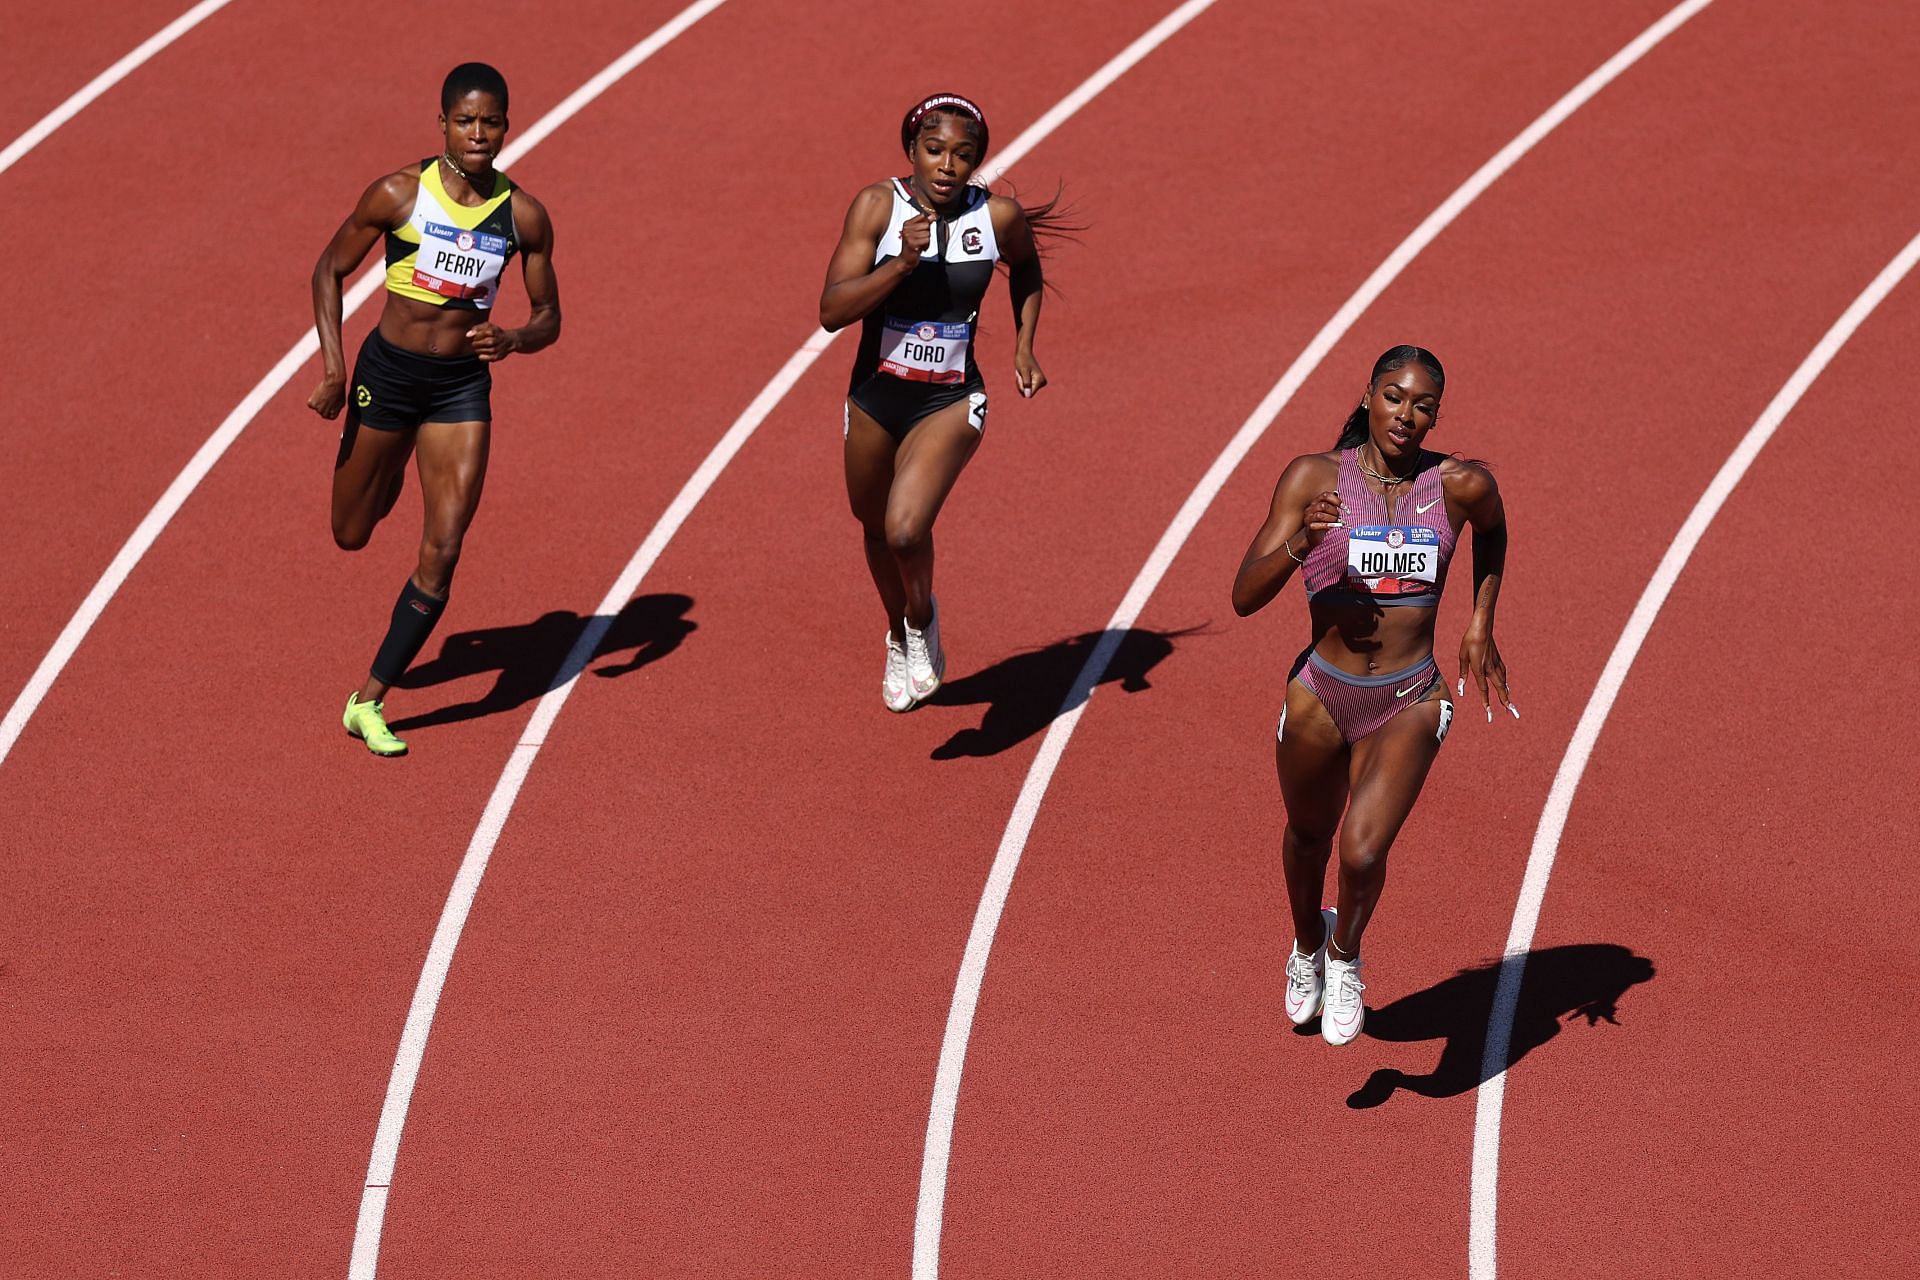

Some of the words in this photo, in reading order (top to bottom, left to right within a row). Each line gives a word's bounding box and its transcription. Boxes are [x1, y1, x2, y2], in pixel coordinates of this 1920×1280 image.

[434, 250, 486, 278] PERRY
[903, 342, 945, 363] FORD
[1361, 552, 1427, 573] HOLMES
